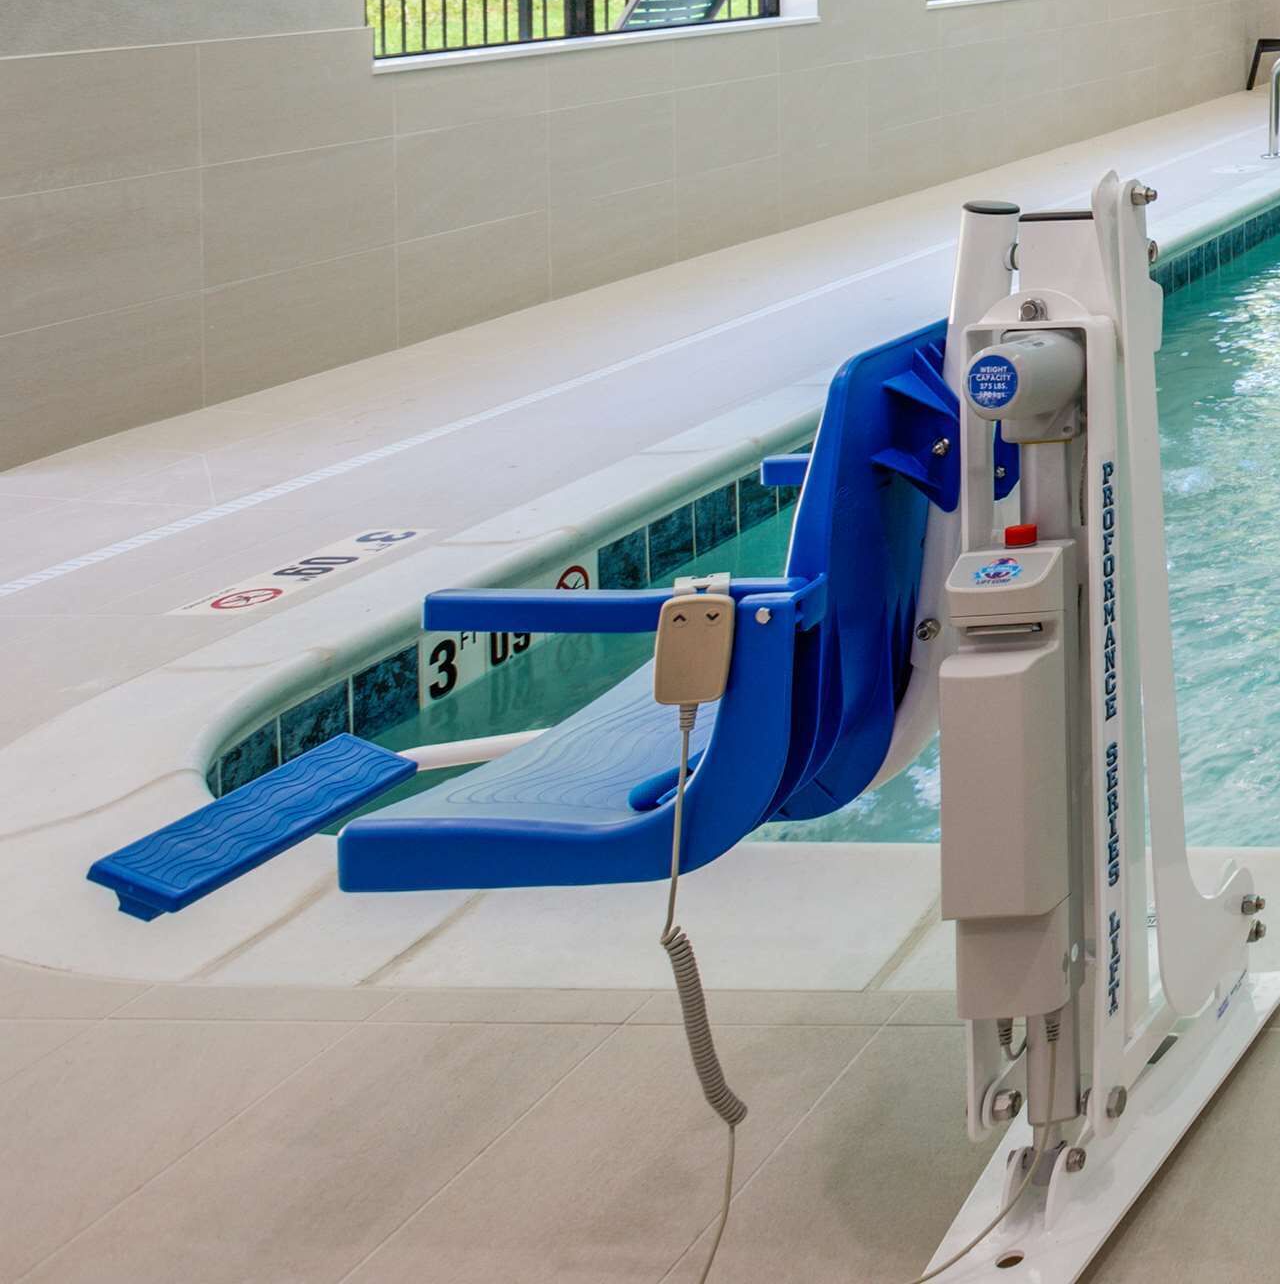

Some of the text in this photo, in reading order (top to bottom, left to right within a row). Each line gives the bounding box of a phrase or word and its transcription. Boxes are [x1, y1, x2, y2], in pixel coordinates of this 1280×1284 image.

[356, 531, 416, 543] 3
[1102, 461, 1117, 721] PROFORMANCE
[429, 639, 457, 700] 3
[1106, 741, 1120, 887] SERIES
